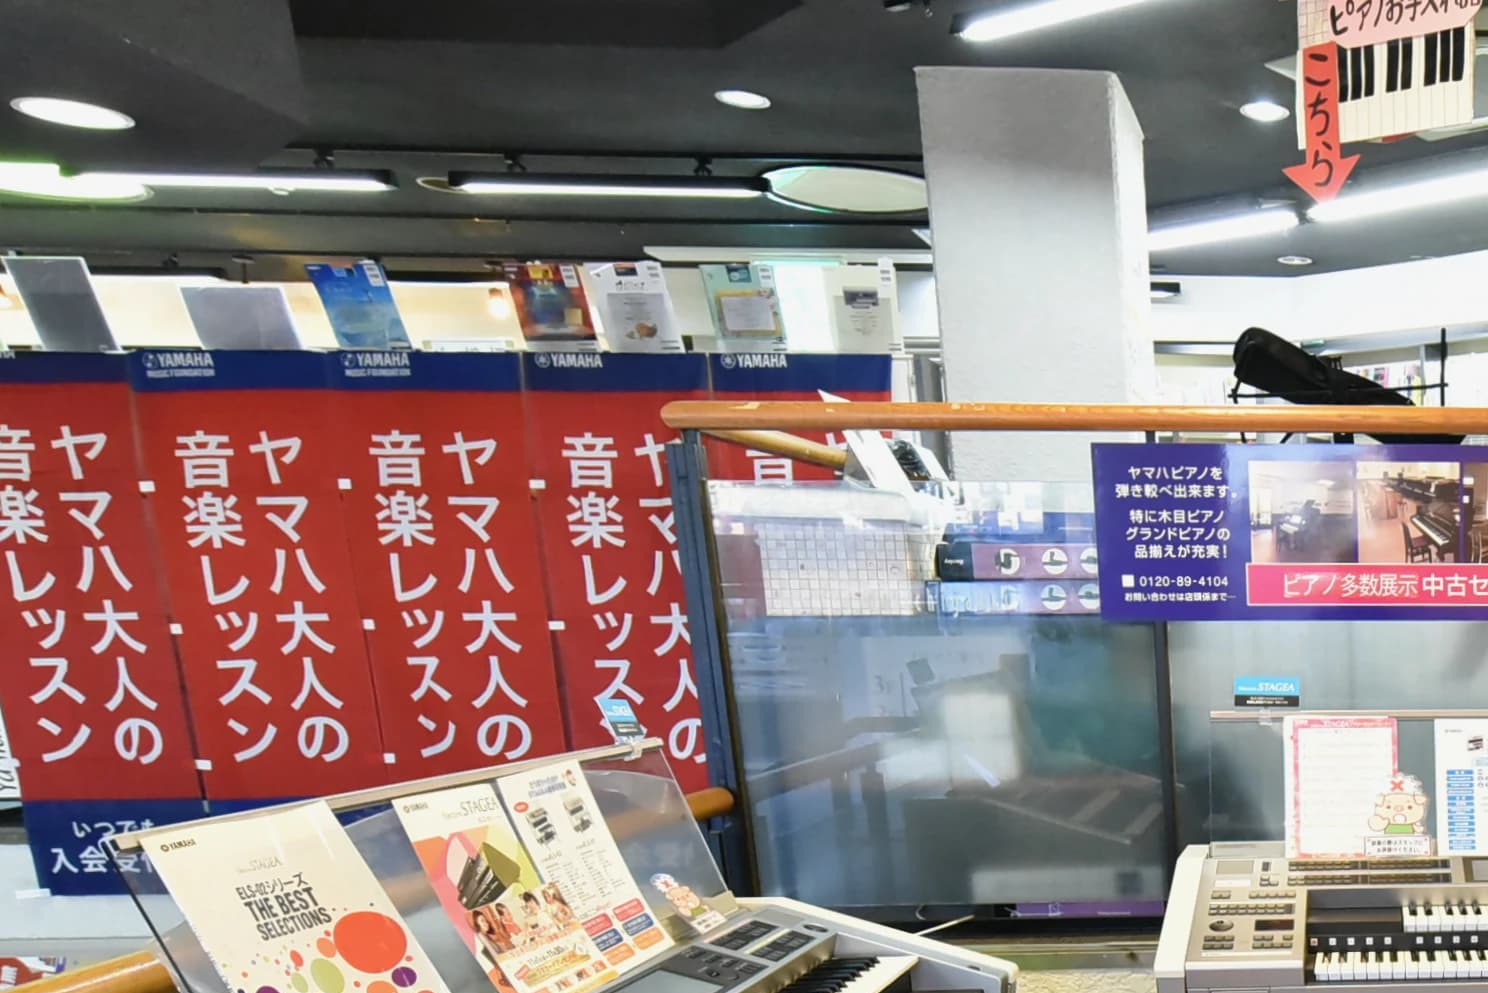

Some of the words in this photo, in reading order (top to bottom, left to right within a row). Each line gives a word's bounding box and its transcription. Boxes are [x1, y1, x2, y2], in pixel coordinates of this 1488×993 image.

[1305, 53, 1334, 187] こちら
[156, 352, 214, 368] YAMAHA
[356, 352, 410, 367] YAMAHA
[550, 353, 603, 368] YAMAHA
[737, 353, 788, 369] YAMAHA
[1128, 466, 1223, 480] ヤマハピアノを
[1129, 510, 1225, 524] 特に木目ピアノ
[1126, 528, 1231, 542] グランドピアノの
[1134, 545, 1228, 559] 品揃えが充実!
[0, 424, 92, 764] 音楽レッスン
[50, 424, 164, 765] ヤマハ大人の
[368, 429, 457, 760] 音楽レッスン
[442, 431, 533, 761] ヤマハ大人の
[562, 432, 648, 738] 音楽レッス
[1139, 576, 1229, 588] 0120-89-4104
[1283, 573, 1418, 598] ピアノ多数展示
[174, 430, 278, 763] 音楽レッスン
[248, 431, 350, 763] ヤマハ大人の
[236, 872, 308, 900] ELS-02シリーズ
[244, 897, 278, 922] THE
[274, 887, 319, 915] BEST
[257, 907, 332, 941] SELECTIONS
